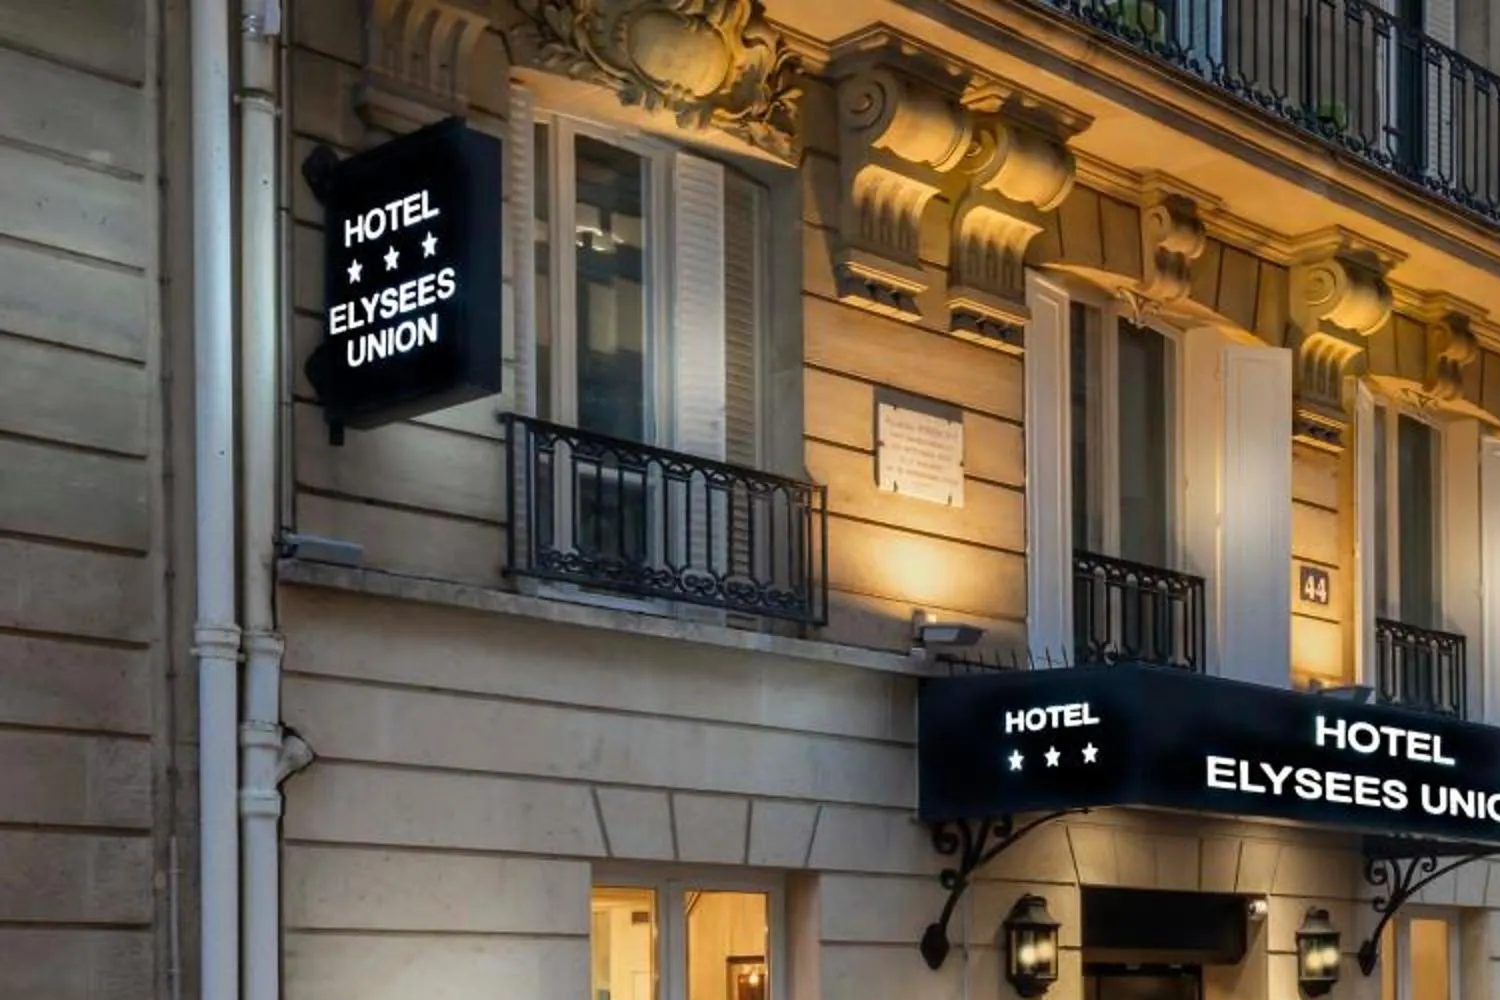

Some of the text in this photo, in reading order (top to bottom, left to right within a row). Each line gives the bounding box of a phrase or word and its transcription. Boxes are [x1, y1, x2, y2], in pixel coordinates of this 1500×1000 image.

[345, 189, 440, 248] HOTEL
[329, 267, 456, 335] ELYSEES
[347, 313, 438, 367] UNION
[1304, 575, 1327, 603] 44
[1005, 702, 1100, 733] HOTEL
[1315, 715, 1455, 766] HOTEL
[1206, 755, 1409, 810] ELYSEES
